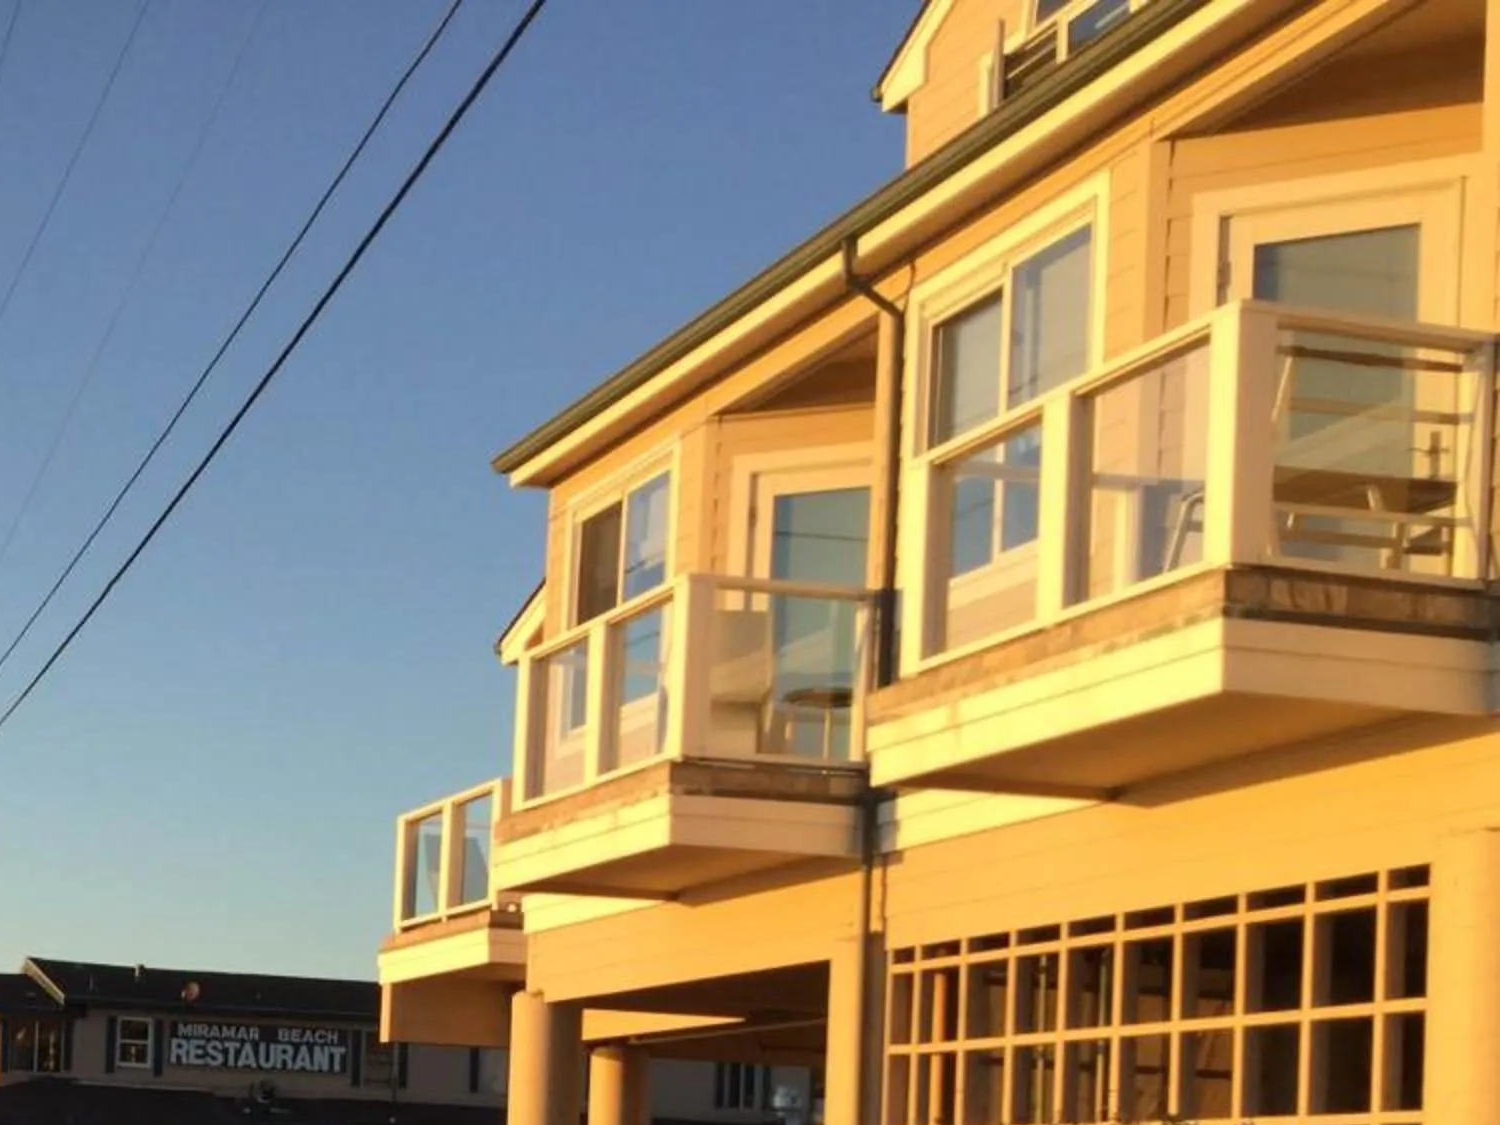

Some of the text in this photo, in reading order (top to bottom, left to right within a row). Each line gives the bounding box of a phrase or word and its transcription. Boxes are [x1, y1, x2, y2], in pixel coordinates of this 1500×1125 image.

[177, 1023, 339, 1044] MIRAMAR BEACH
[170, 1037, 346, 1073] RESTAURANT
